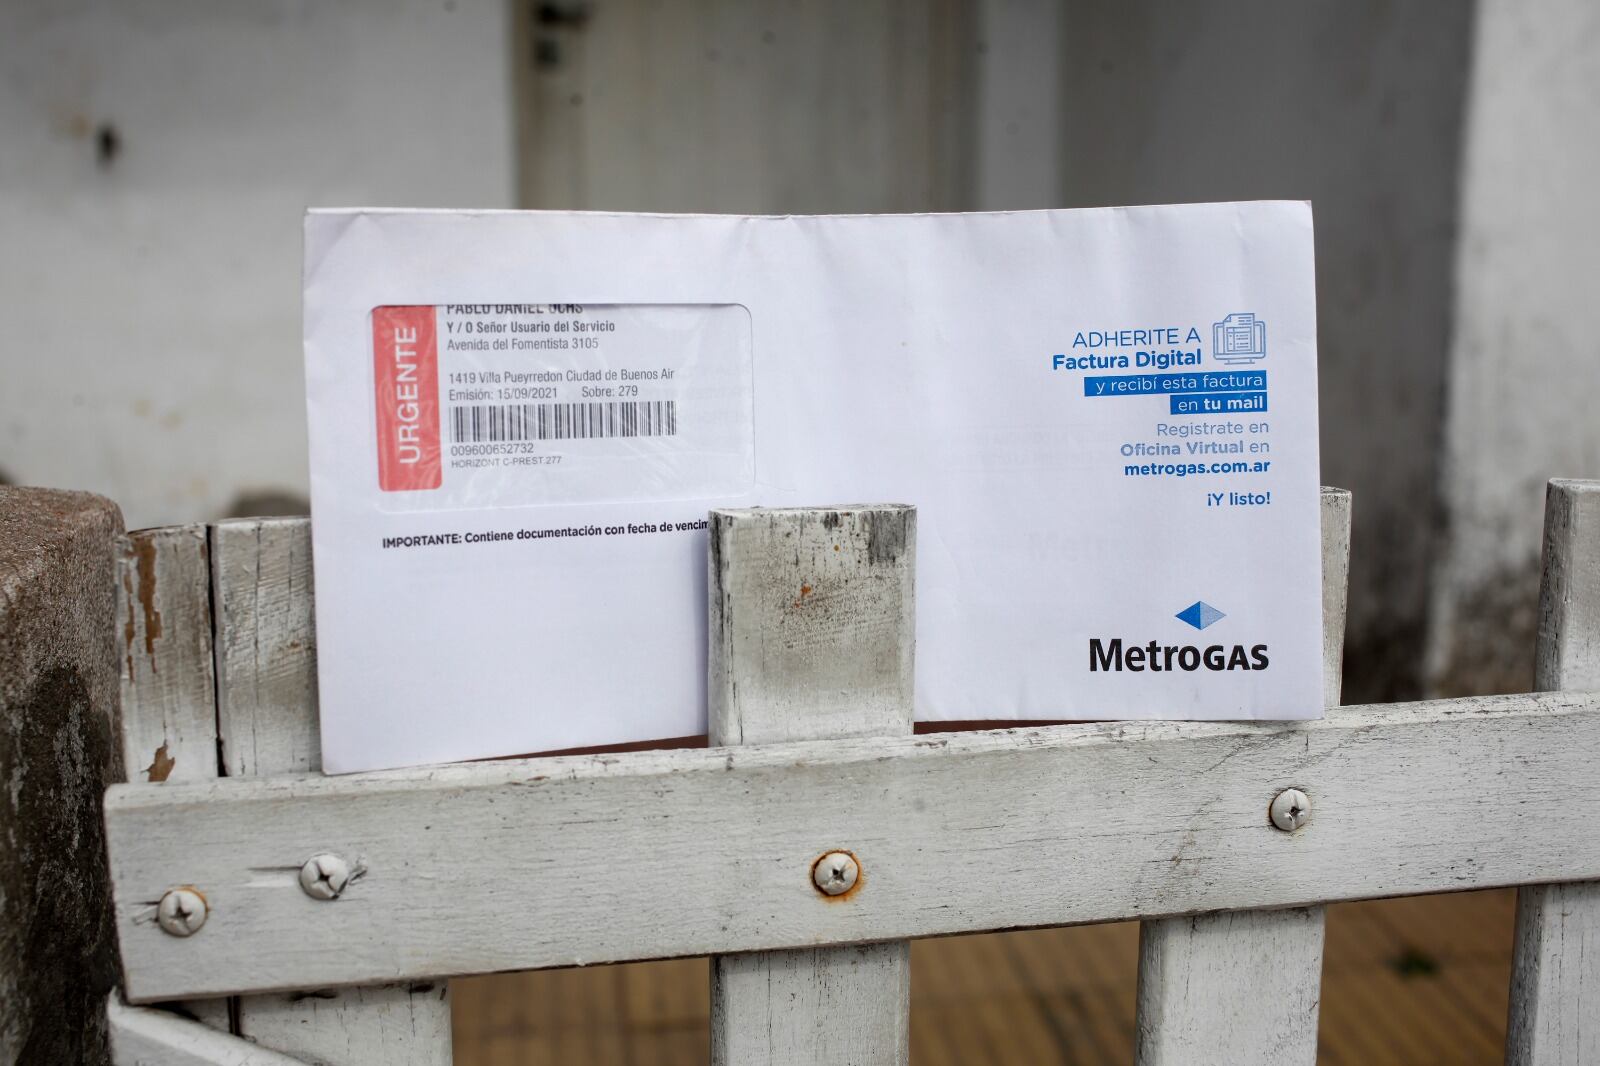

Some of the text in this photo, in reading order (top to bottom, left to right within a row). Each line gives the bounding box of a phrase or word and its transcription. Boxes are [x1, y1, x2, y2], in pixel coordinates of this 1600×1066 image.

[447, 322, 454, 333] Y
[457, 322, 462, 333] /
[477, 321, 507, 333] Señor
[511, 321, 550, 333] Usuario
[554, 321, 569, 333] del
[573, 320, 615, 332] Servicio
[447, 337, 599, 351] Avenida del Fomentista 3105
[1072, 327, 1202, 349] ADHERITE A
[1052, 348, 1202, 371] Factura Digital
[449, 367, 675, 384] 1419 Villa Pueyrredon Ciudad de Buenos Air
[449, 385, 638, 401] Emisión: 15/09/2021 Sobre: 279
[1096, 374, 1264, 395] y recibí esta factura
[394, 327, 421, 465] URGENTE
[1178, 396, 1264, 412] en tu mail
[1157, 421, 1269, 438] Registrate en
[451, 443, 534, 456] 009600652732
[1120, 440, 1270, 457] Oficina Virtual en
[1124, 461, 1271, 477] metrogas.com.ar
[1207, 491, 1271, 507] ¡Y listo!
[382, 533, 462, 549] IMPORTANTE:
[464, 530, 514, 544] Contiene
[516, 525, 601, 540] documentación
[604, 524, 625, 536] con
[627, 522, 657, 535] fecha
[659, 521, 673, 532] de
[1089, 638, 1270, 672] MetroGAS
